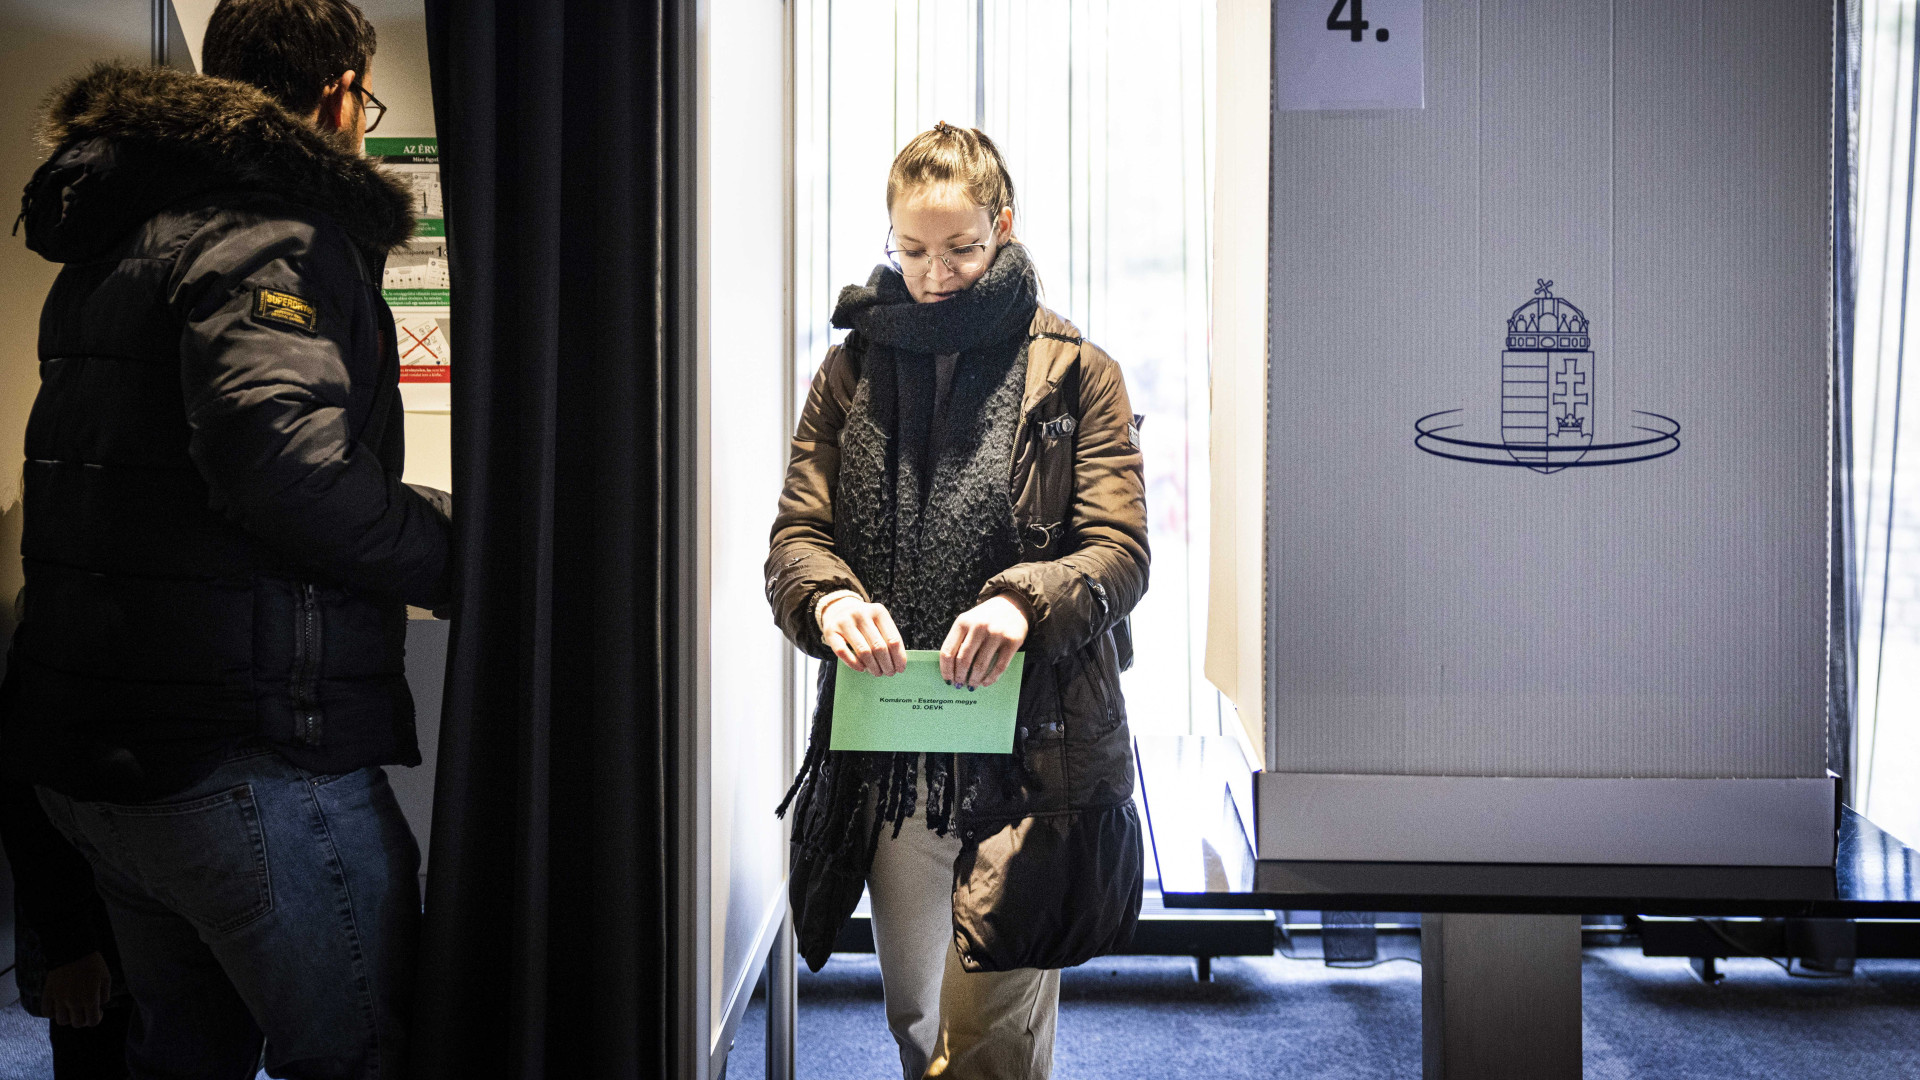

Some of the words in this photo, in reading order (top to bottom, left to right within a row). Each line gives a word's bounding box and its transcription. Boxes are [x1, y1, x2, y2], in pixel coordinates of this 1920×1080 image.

[1326, 0, 1389, 42] 4.
[403, 145, 416, 154] AZ
[266, 294, 308, 312] SUPERDRY
